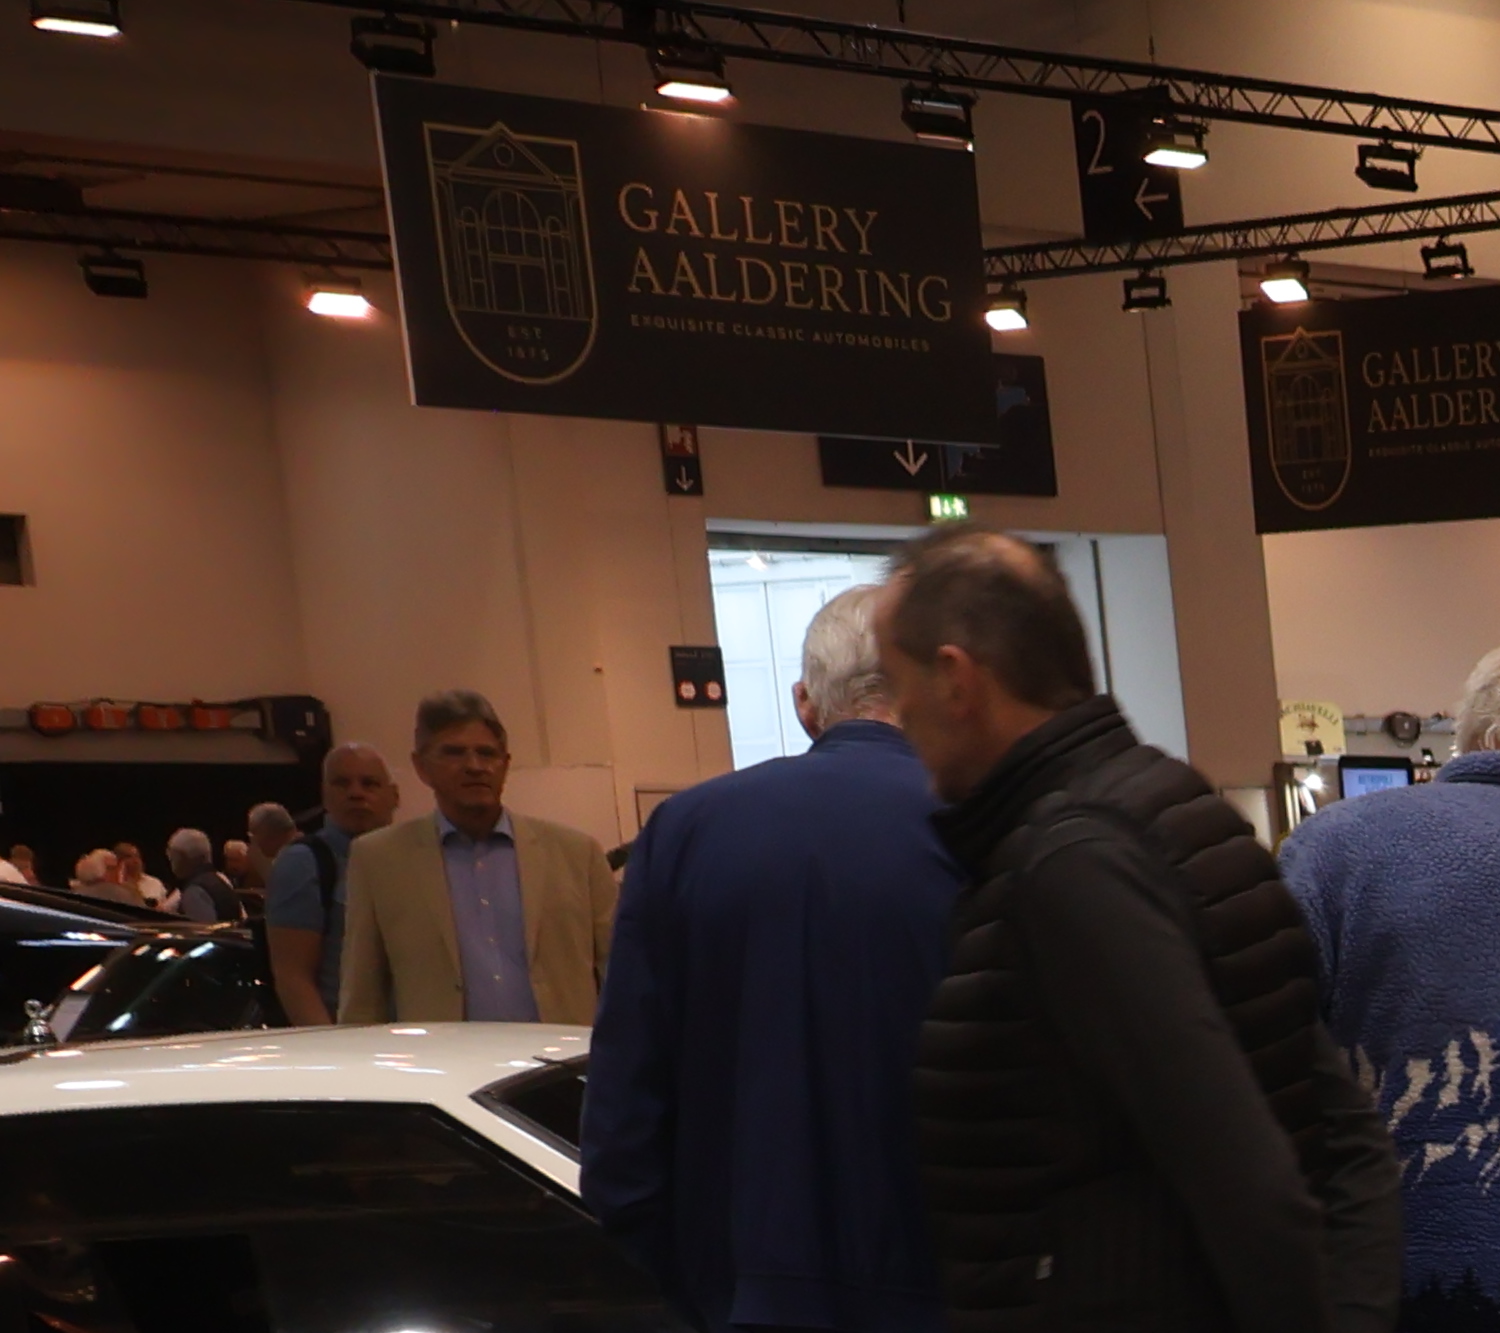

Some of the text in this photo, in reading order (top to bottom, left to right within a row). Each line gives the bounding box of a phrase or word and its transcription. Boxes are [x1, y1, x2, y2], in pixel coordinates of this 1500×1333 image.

[1081, 109, 1114, 176] 2
[617, 181, 879, 257] GALLERY
[626, 246, 954, 323] AALDERING
[630, 313, 931, 353] EXQUISITE CLASSIC AUTOMOBILES
